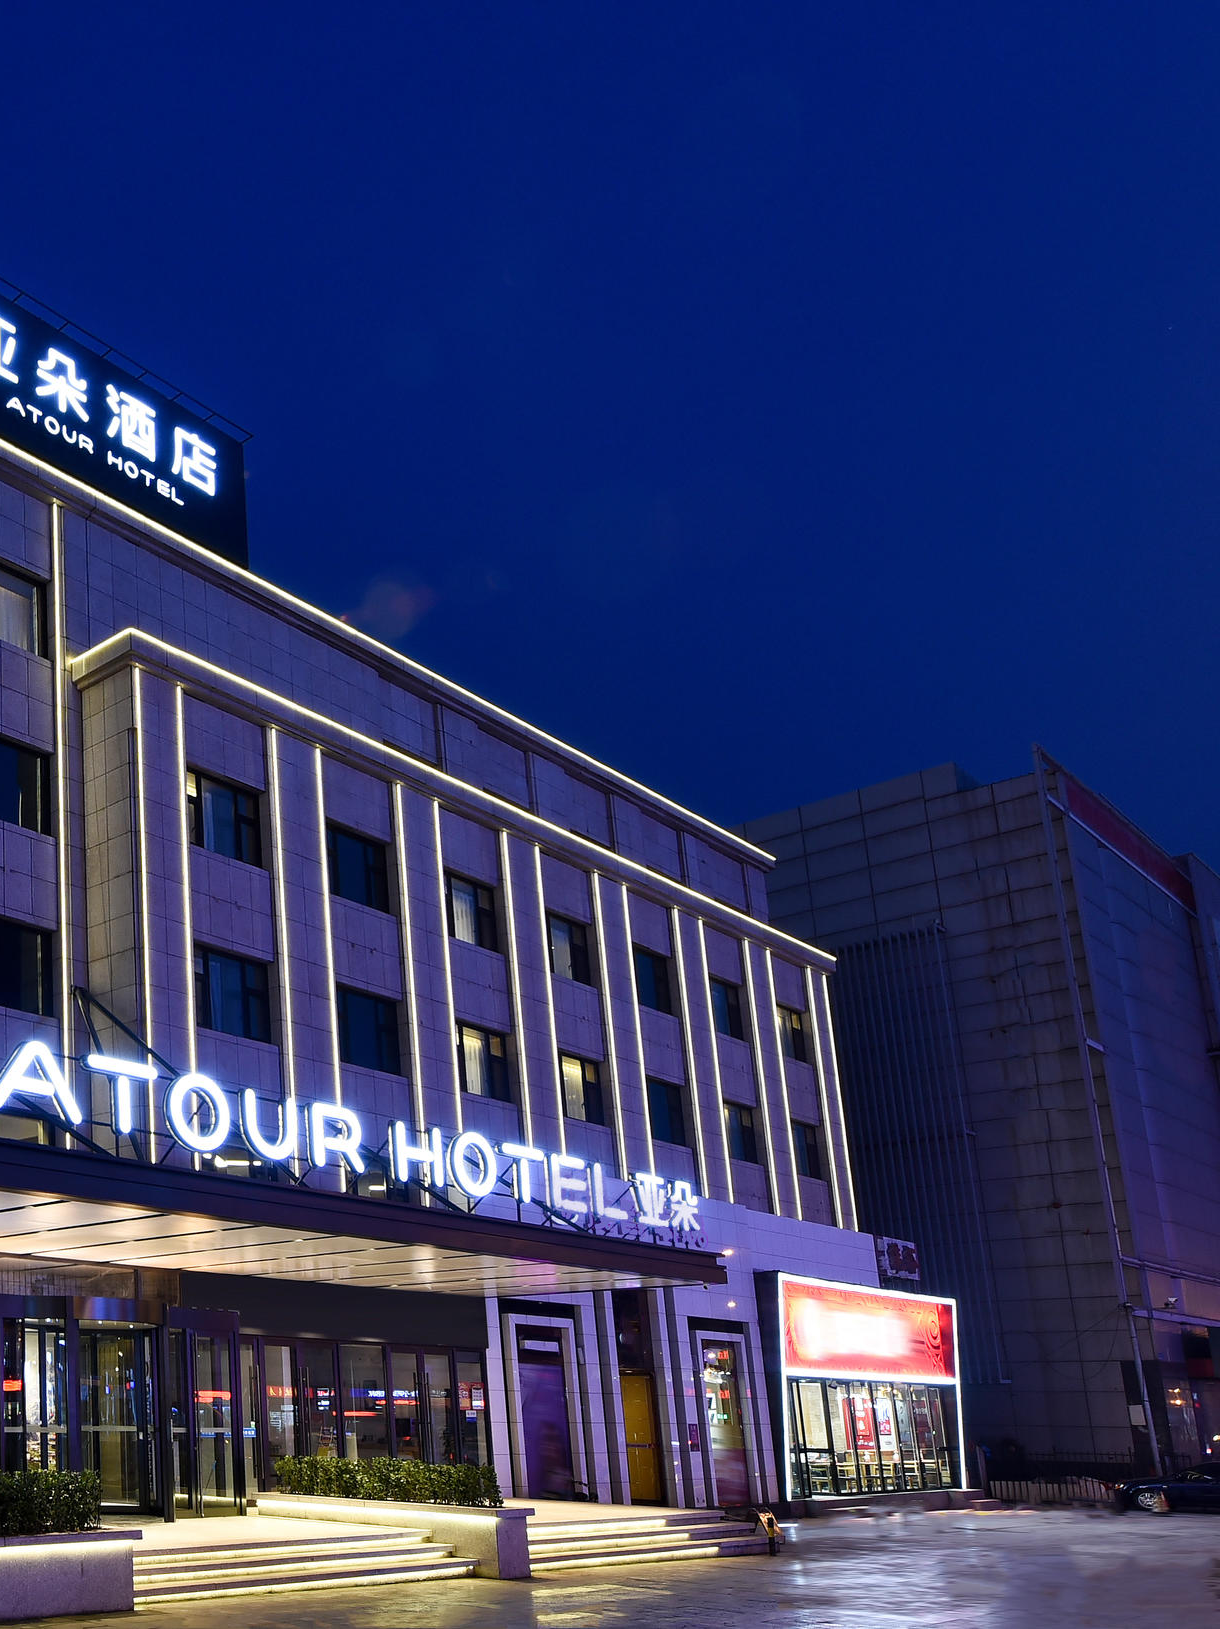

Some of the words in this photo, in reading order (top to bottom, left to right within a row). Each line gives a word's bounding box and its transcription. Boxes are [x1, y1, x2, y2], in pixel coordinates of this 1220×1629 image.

[6, 397, 94, 455] ATOUR
[106, 451, 185, 506] HOTEL
[388, 1120, 629, 1221] HOTEL
[631, 1172, 701, 1232] 亚朵
